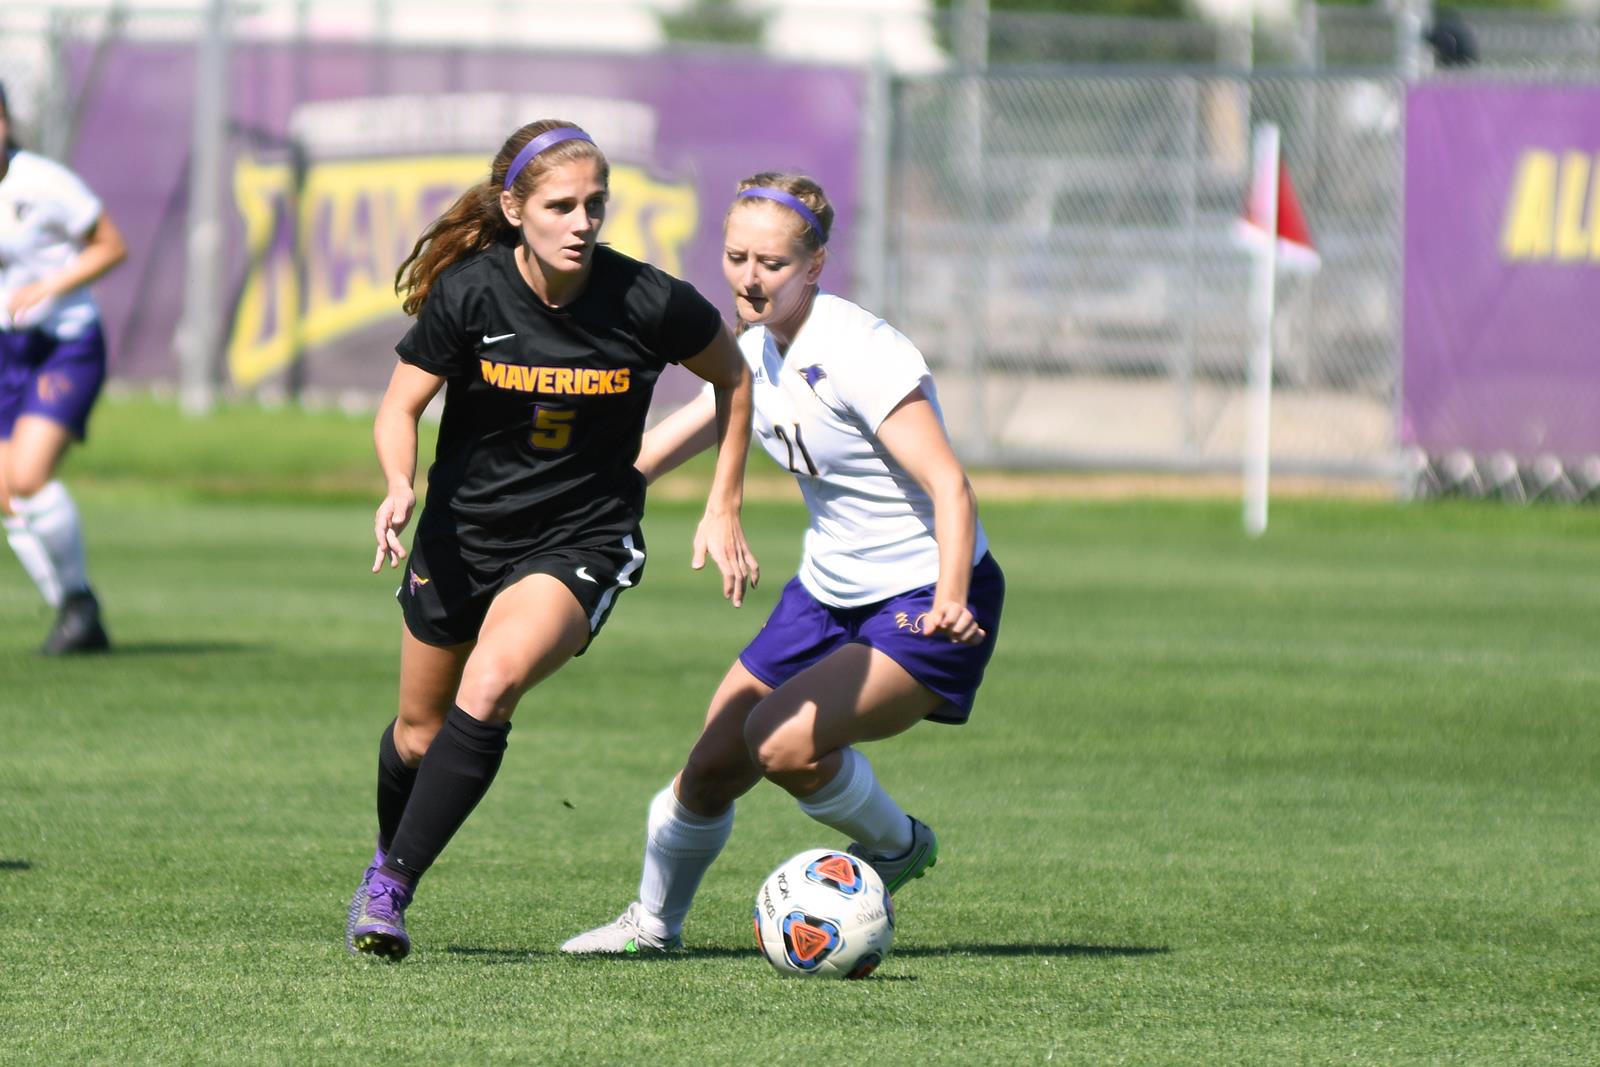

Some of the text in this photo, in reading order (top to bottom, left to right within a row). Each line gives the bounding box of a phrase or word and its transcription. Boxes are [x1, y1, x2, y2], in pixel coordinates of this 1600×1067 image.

[1505, 149, 1600, 261] AL
[479, 358, 631, 395] MAVERICKS
[528, 404, 576, 450] 5
[774, 422, 818, 476] 21
